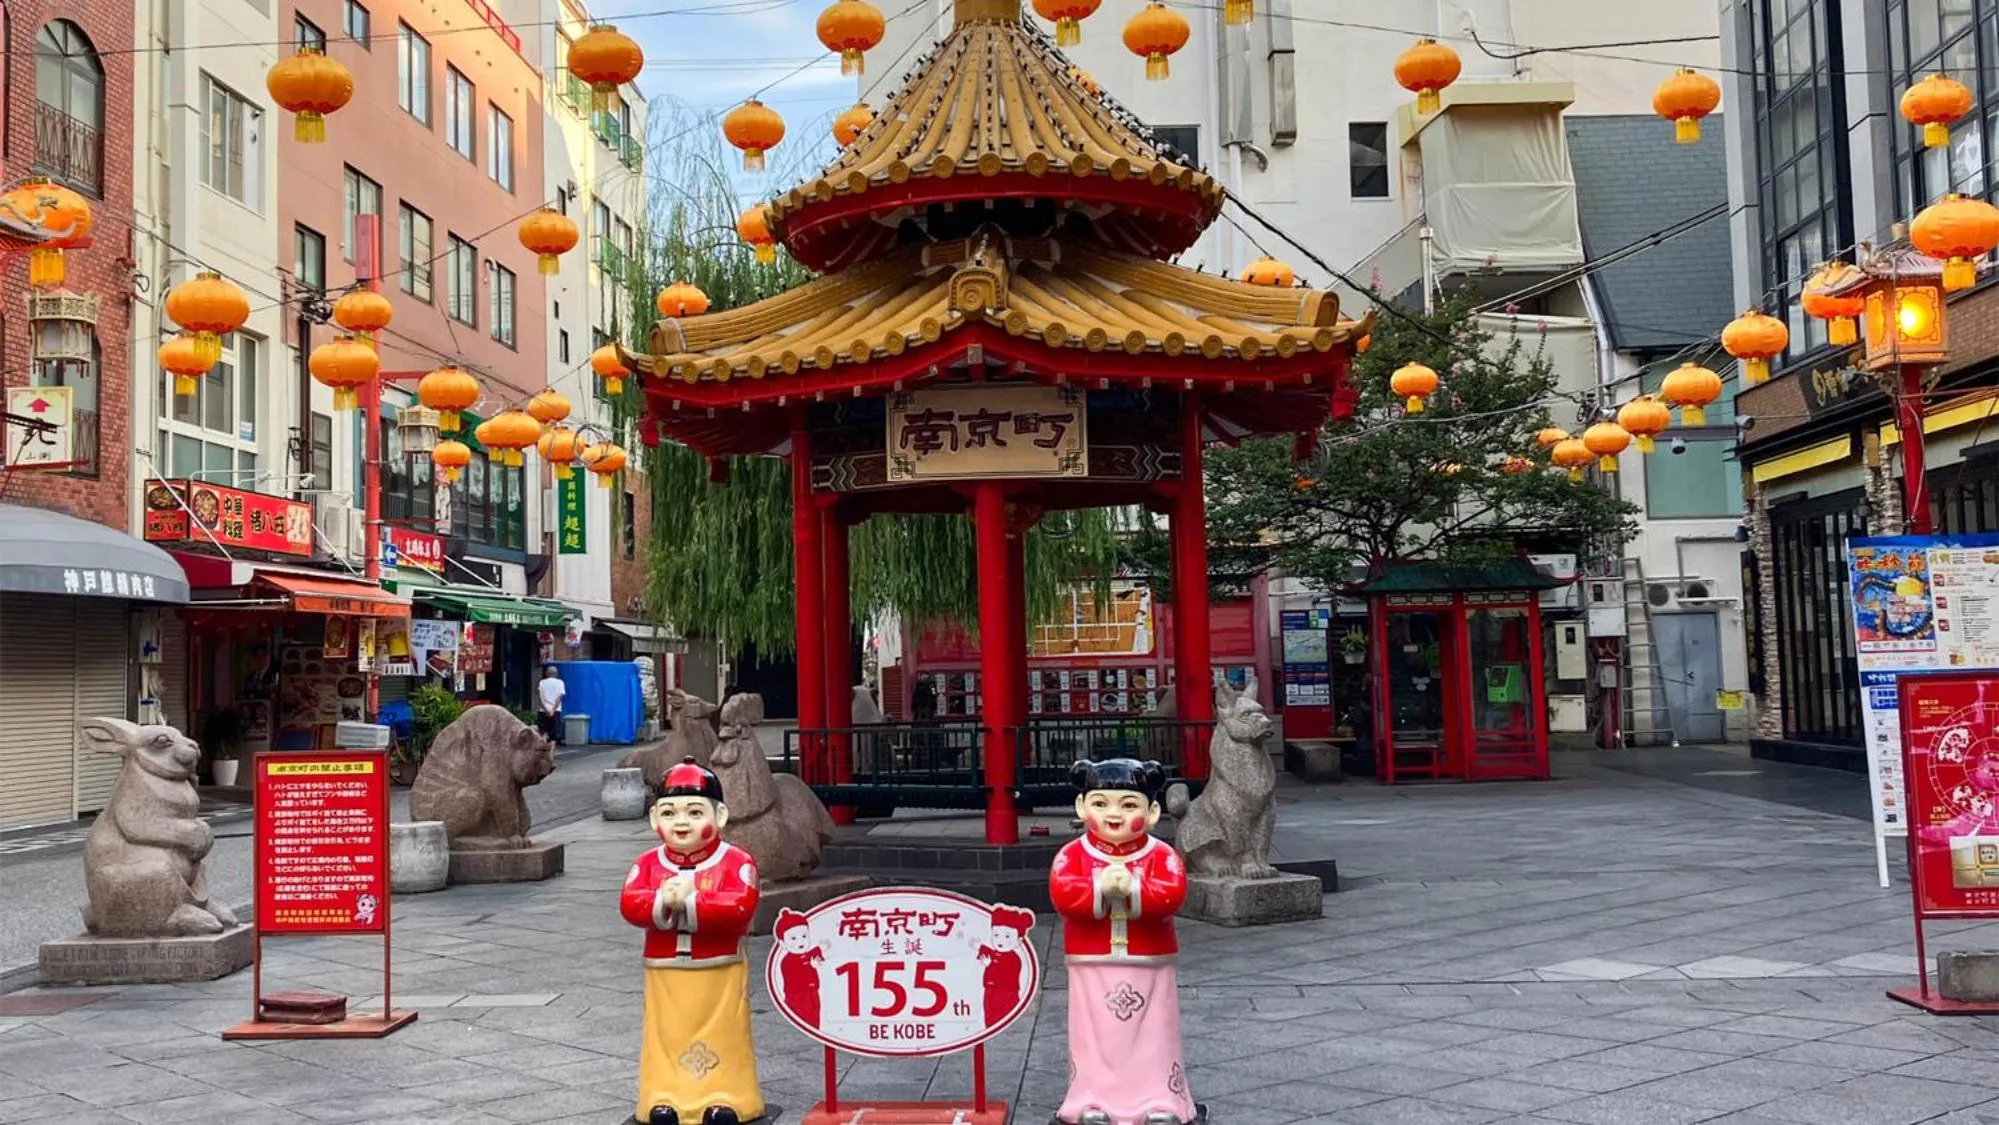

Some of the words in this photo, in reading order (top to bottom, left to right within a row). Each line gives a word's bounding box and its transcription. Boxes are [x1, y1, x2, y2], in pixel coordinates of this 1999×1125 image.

[899, 407, 1074, 455] 南京町
[838, 907, 960, 940] 南京町
[880, 938, 923, 956] 生誕
[869, 1024, 889, 1040] BE
[894, 1024, 936, 1040] KOBE
